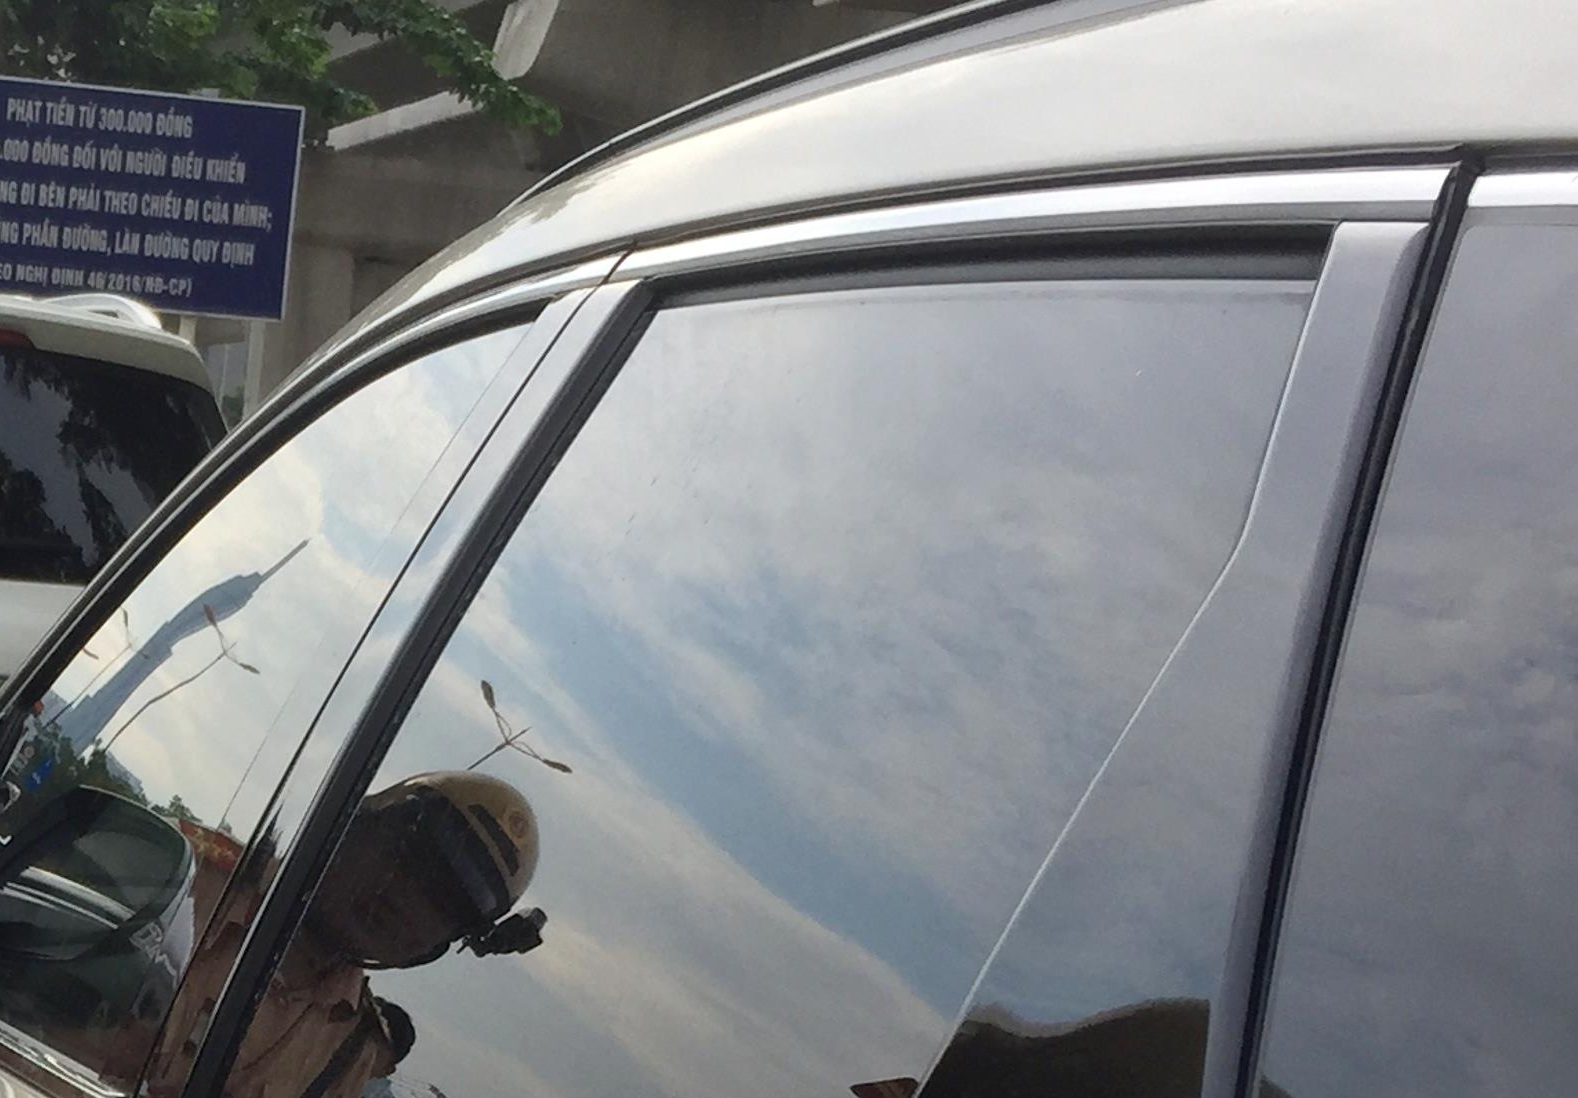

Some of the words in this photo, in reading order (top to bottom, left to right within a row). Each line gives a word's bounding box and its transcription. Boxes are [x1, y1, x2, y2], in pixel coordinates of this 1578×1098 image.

[6, 98, 42, 128] PHẠT
[98, 107, 153, 135] 300.000
[72, 140, 96, 169] ĐỐI
[20, 182, 35, 206] ĐI
[37, 180, 66, 208] BÊN
[68, 183, 101, 212] PHẢI
[103, 189, 138, 216] THEO
[184, 197, 199, 222] ĐI
[202, 195, 230, 226] CỦA
[192, 239, 220, 264] QUY
[221, 241, 255, 268] ĐỊNH
[15, 264, 48, 287] NGHỊ
